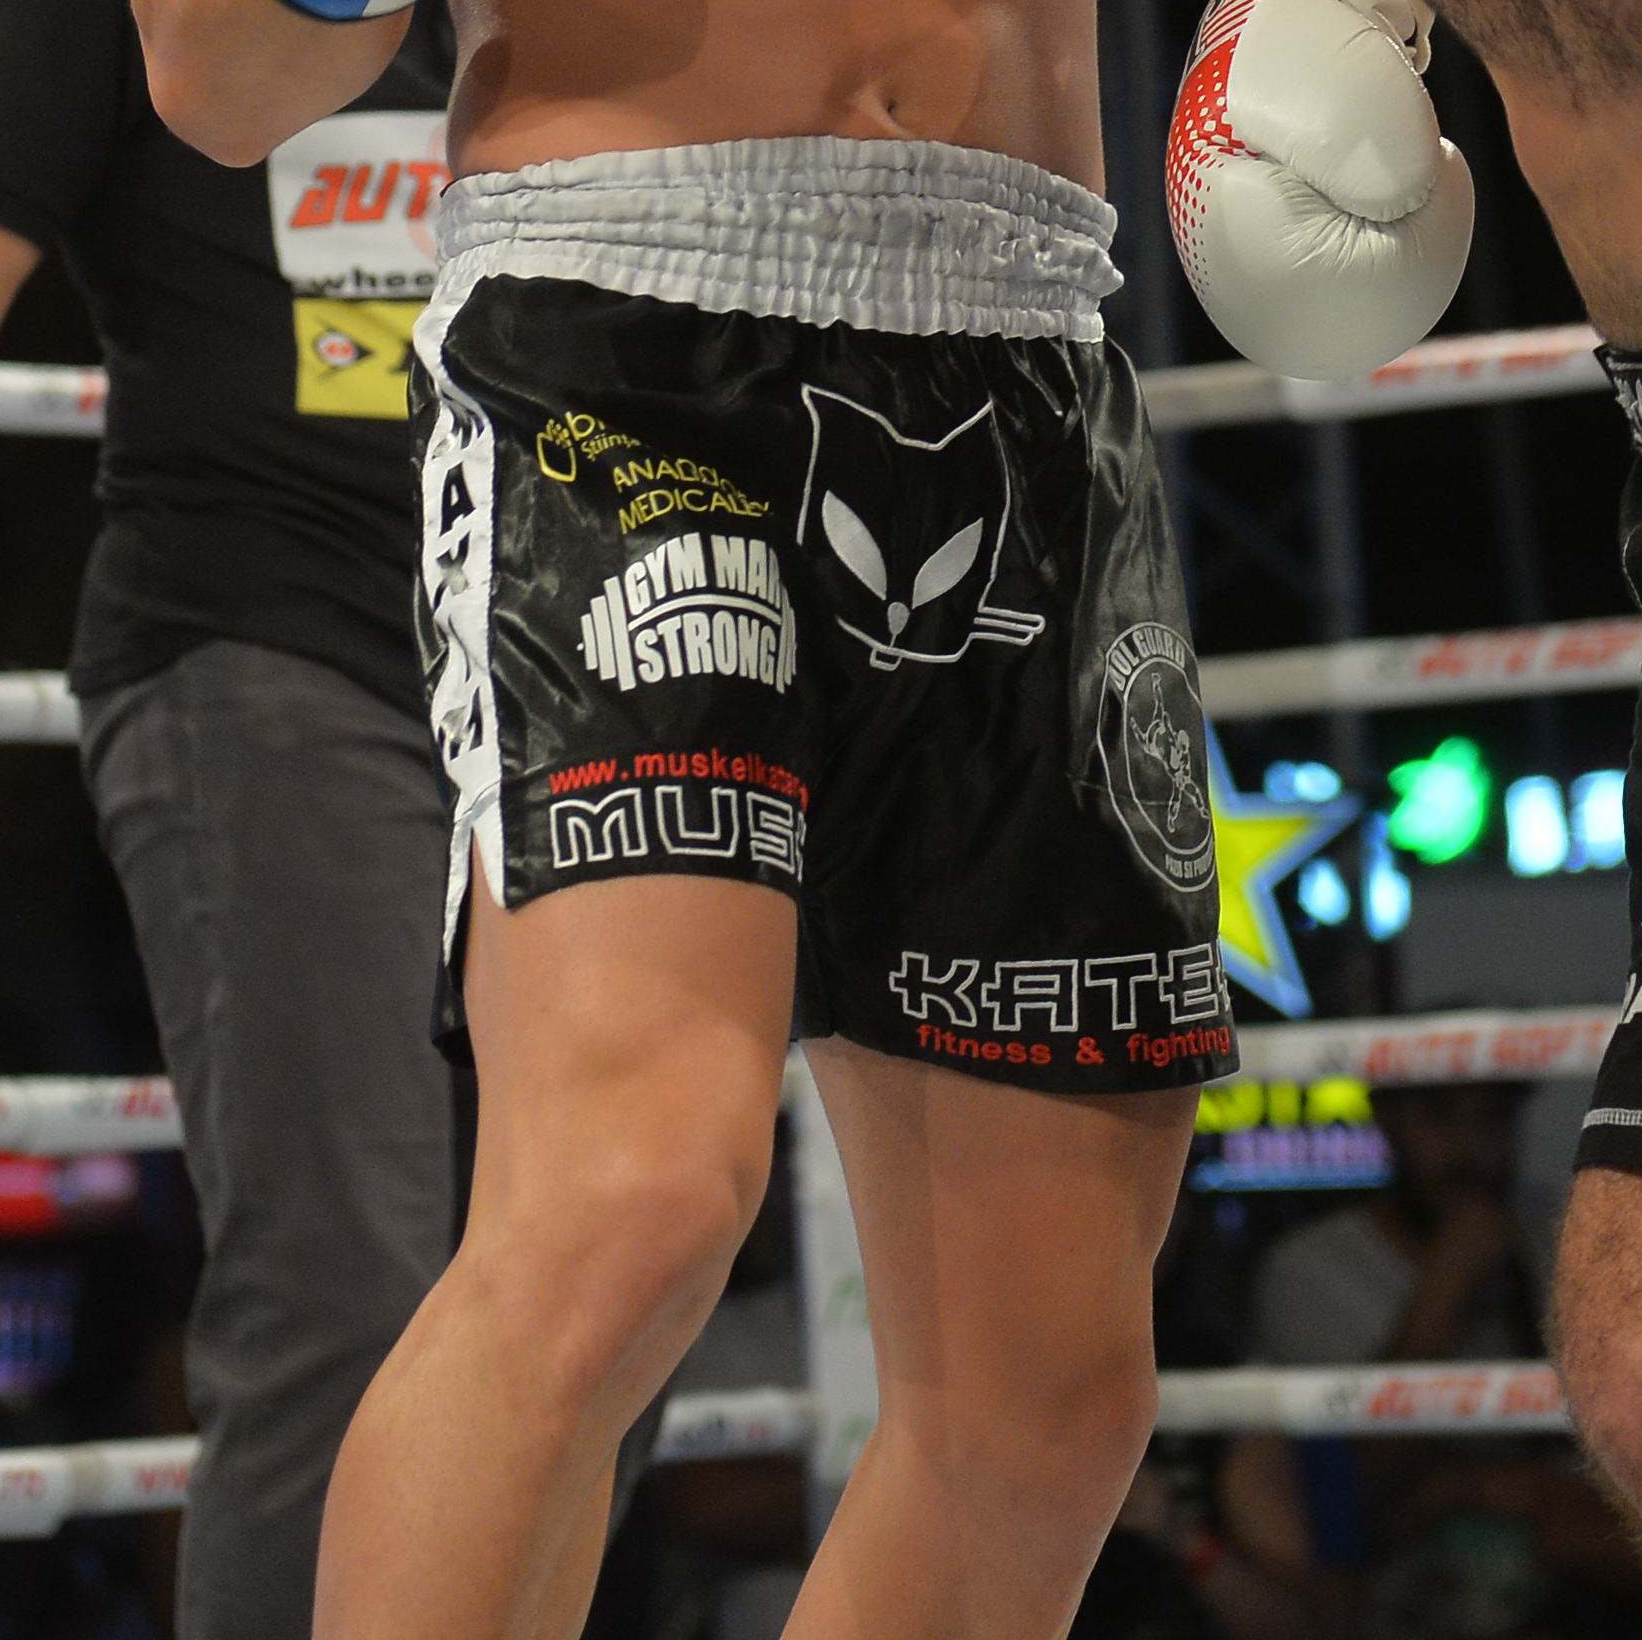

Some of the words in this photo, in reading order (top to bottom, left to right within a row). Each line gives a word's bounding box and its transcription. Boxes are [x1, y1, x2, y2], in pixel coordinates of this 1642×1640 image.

[290, 161, 453, 228] AUT
[303, 267, 434, 296] whee
[625, 531, 707, 616] GYM
[634, 609, 777, 685] STRONG
[550, 785, 807, 887] MUS
[889, 943, 1230, 1033] KATE
[916, 1023, 1052, 1064] fitness
[1076, 1037, 1105, 1064] &
[1126, 1026, 1232, 1067] fighting
